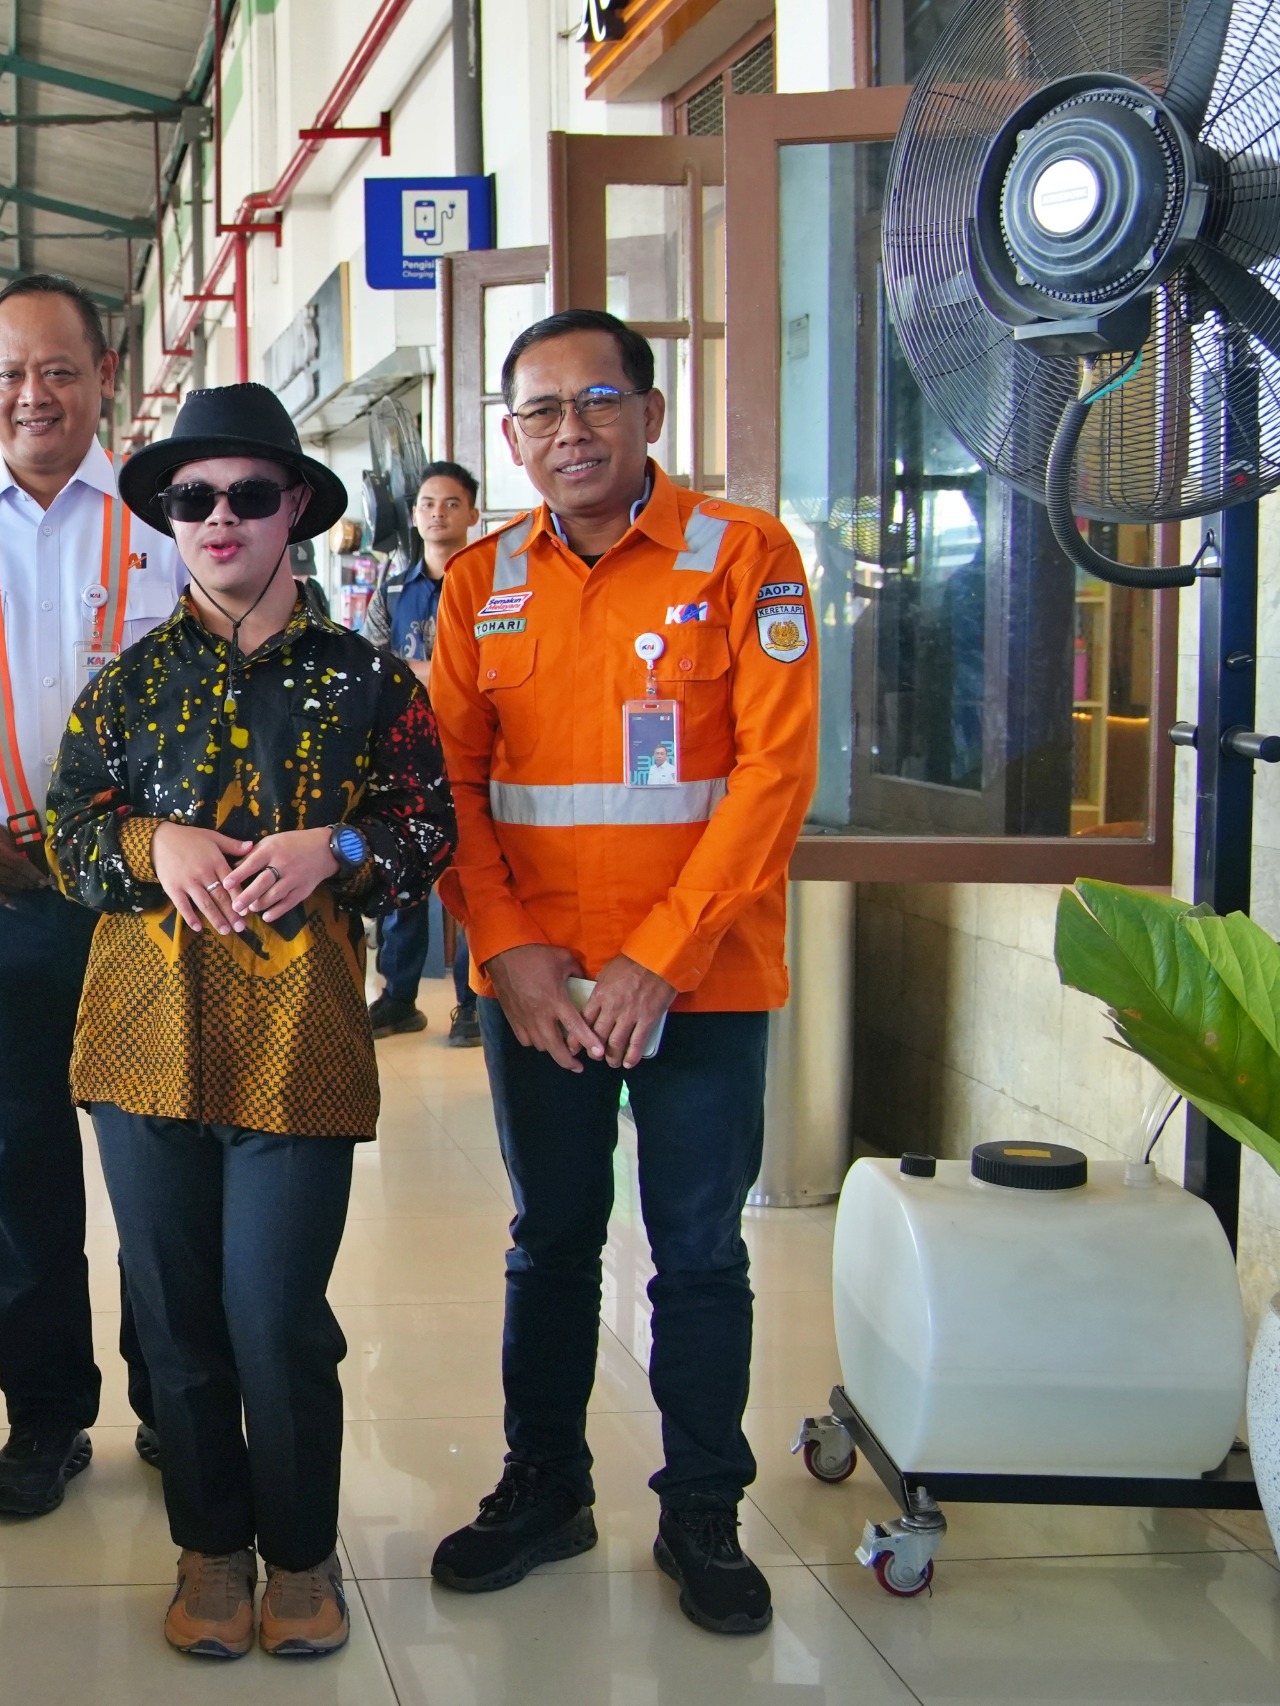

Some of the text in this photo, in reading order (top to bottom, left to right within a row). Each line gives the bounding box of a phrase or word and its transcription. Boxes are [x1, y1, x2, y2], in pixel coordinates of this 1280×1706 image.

[402, 260, 434, 271] Pengisi
[402, 270, 434, 279] Charging
[128, 552, 147, 569] AI
[758, 585, 800, 599] DAOP 7
[488, 597, 522, 606] Semakin
[487, 603, 521, 611] Melayani
[759, 606, 789, 616] KERETA
[665, 602, 708, 624] KAI
[477, 620, 521, 634] TOHARI
[87, 656, 106, 665] KAI
